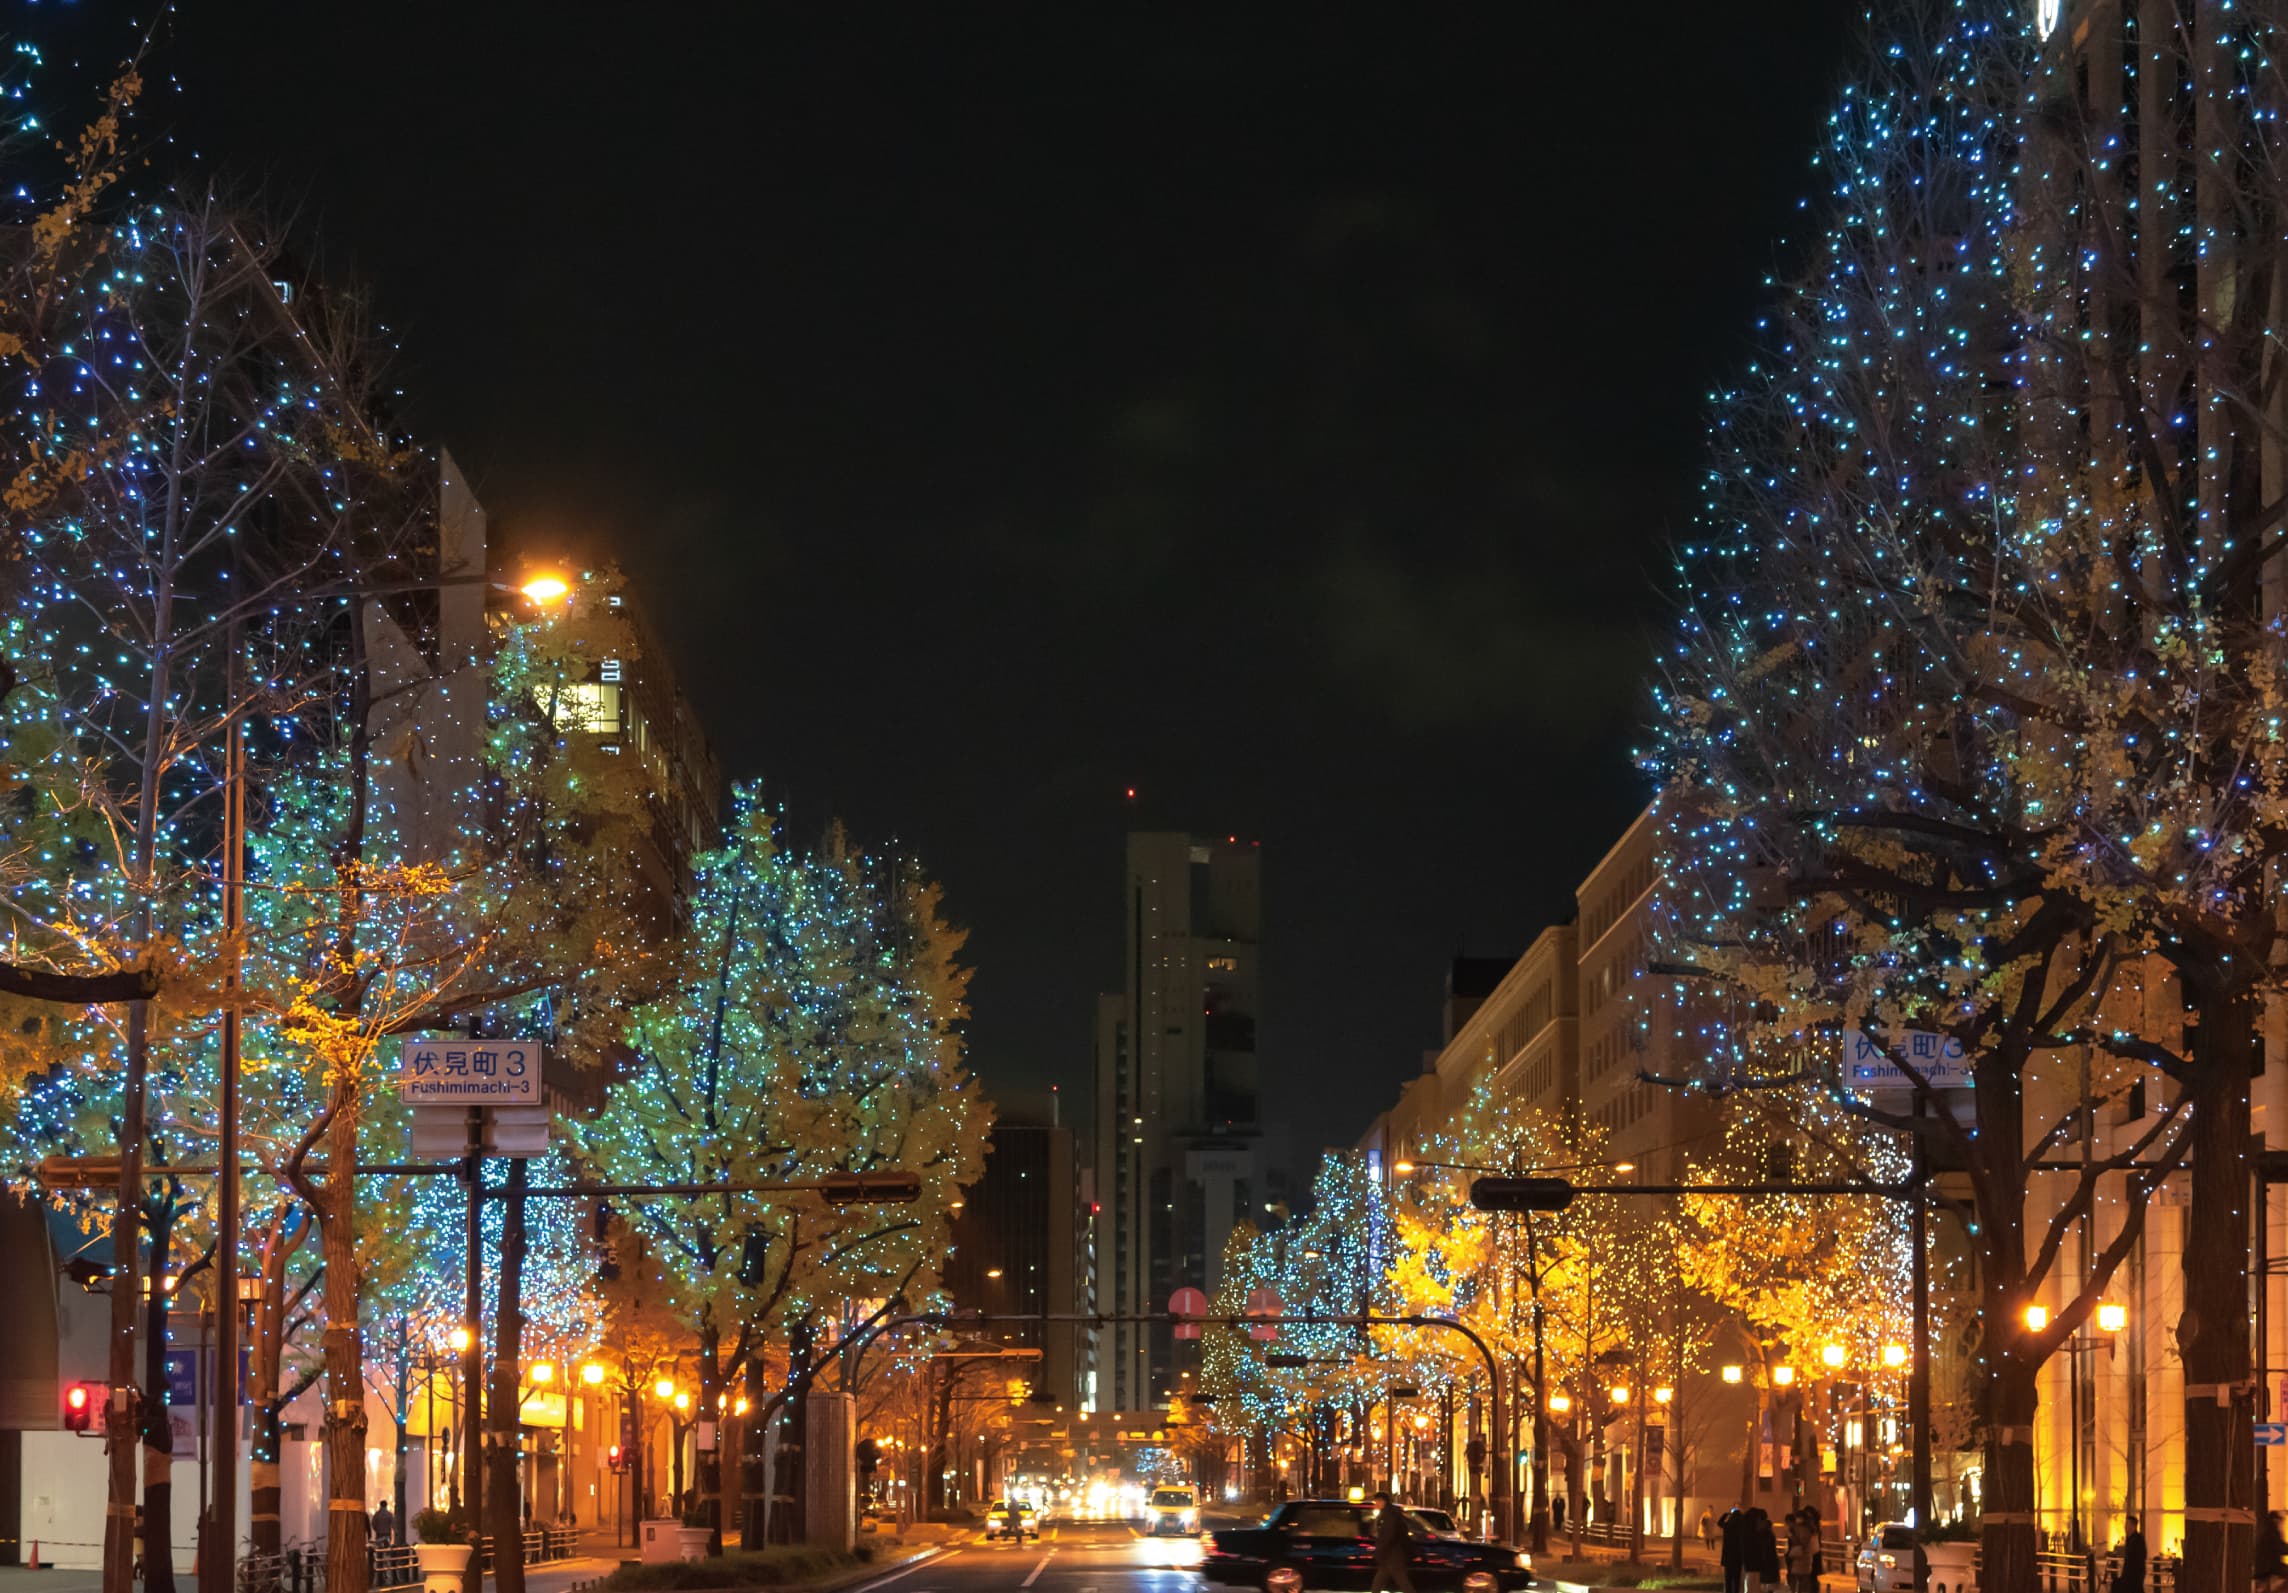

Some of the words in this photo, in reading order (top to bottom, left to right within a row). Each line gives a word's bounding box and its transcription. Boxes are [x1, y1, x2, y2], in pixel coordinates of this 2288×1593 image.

[414, 1050, 526, 1077] 伏見町3
[1852, 1064, 1970, 1078] Fshimachi-
[411, 1080, 530, 1094] Fushimimachi-3
